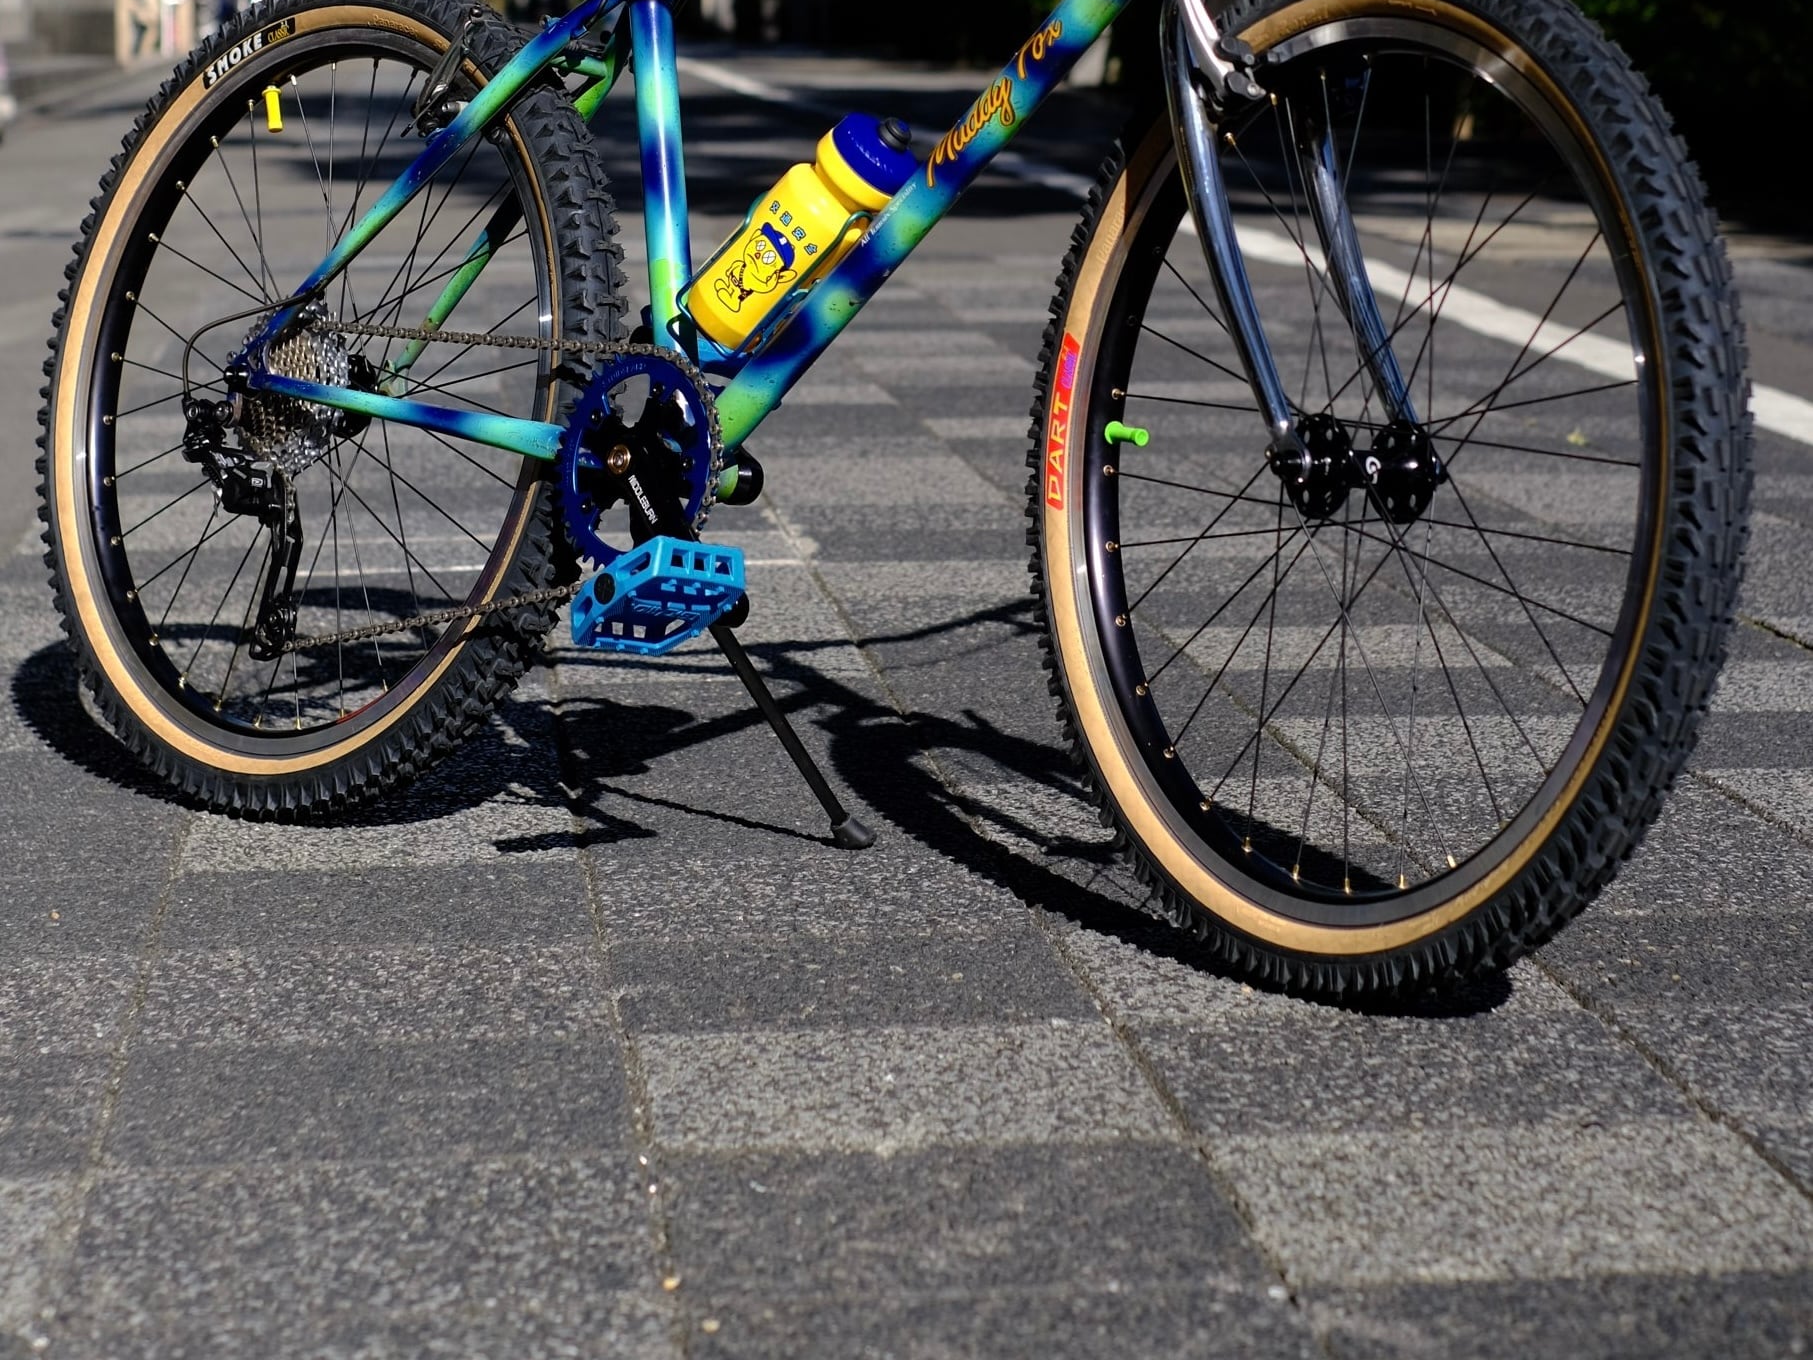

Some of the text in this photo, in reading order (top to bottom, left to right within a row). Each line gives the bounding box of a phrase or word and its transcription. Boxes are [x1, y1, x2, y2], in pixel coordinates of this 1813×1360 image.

[207, 32, 263, 85] SMOKE
[926, 77, 1014, 187] Muddy
[768, 199, 819, 256] 交通安全
[1048, 391, 1068, 502] DART
[628, 474, 659, 525] MIDDLEBURN
